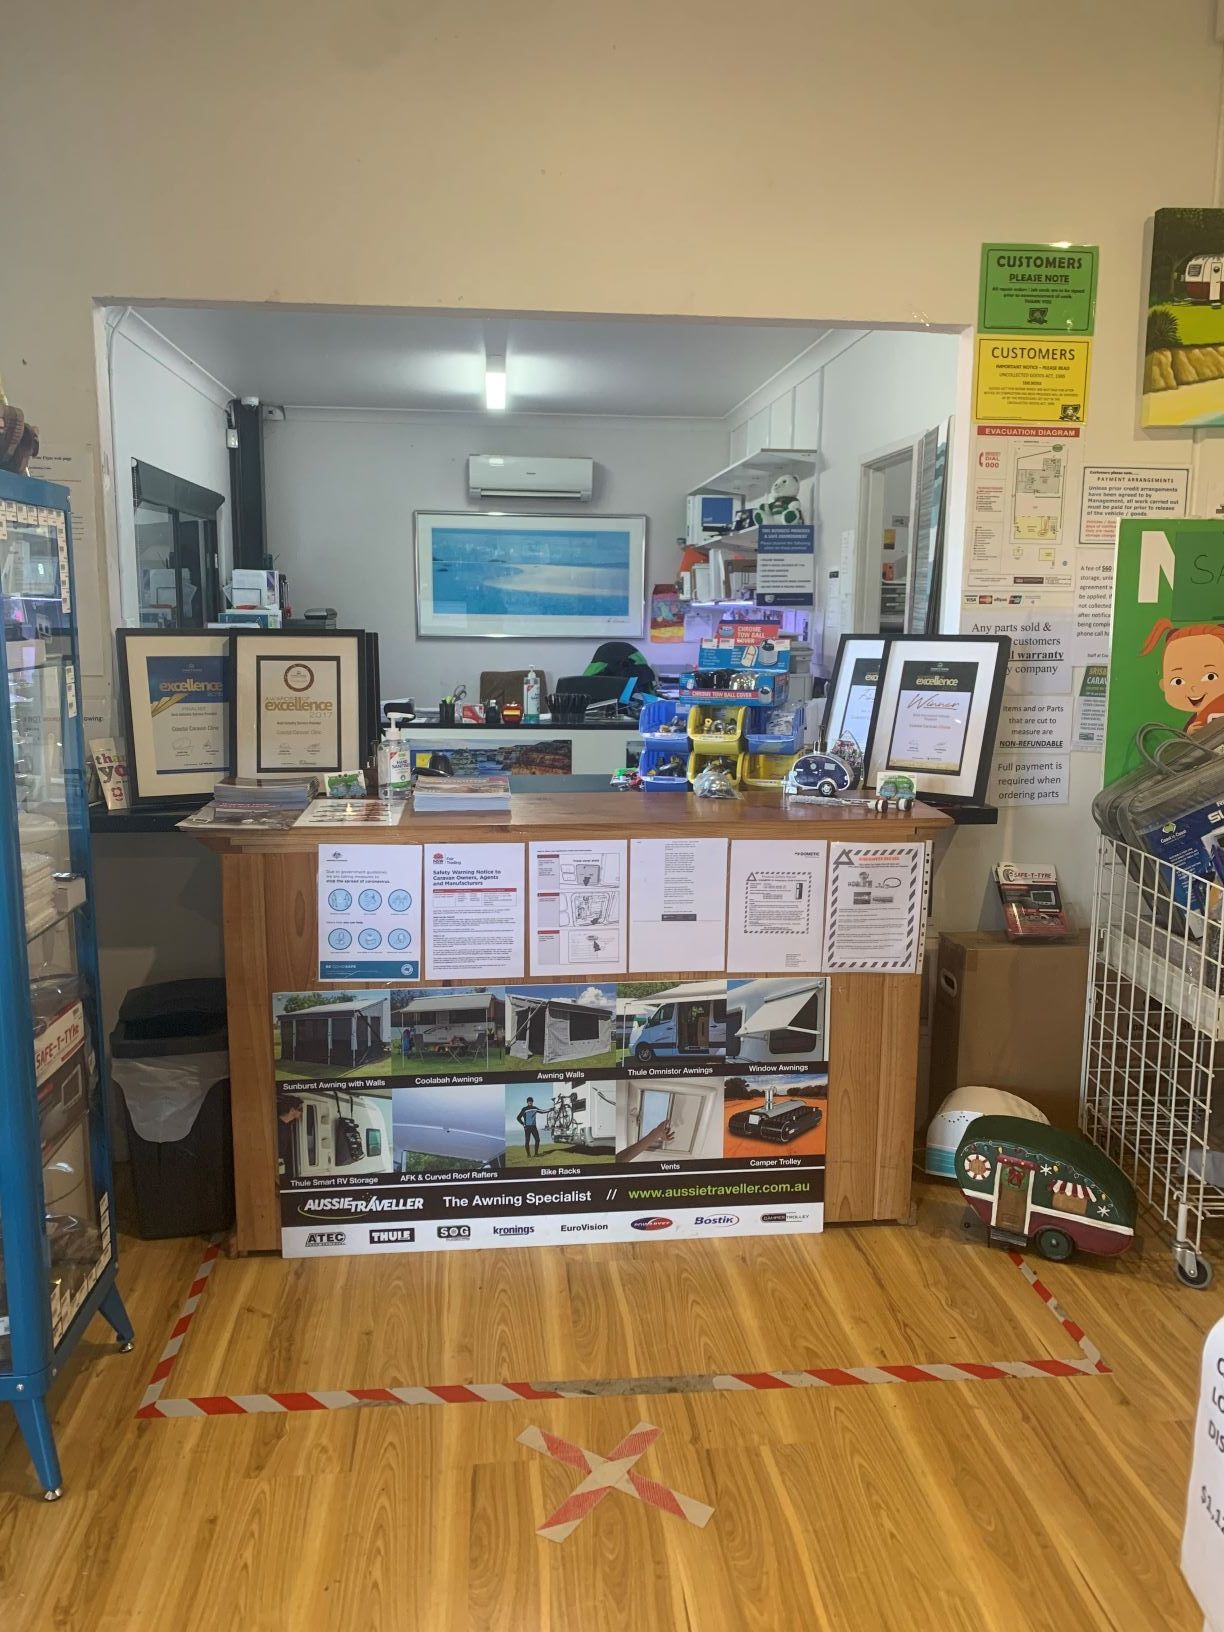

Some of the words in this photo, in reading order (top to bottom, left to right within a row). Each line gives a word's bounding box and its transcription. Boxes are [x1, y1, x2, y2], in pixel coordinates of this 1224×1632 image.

[996, 255, 1082, 269] CUSTOMERS
[1009, 273, 1043, 283] PLEASE
[1045, 275, 1070, 283] NOTE
[992, 346, 1075, 360] CUSTOMERS
[985, 428, 1036, 436] EVACUATION
[972, 623, 992, 634] Any
[994, 623, 1018, 634] parts
[1021, 622, 1040, 632] sold
[1043, 621, 1052, 631] &
[1013, 637, 1061, 646] customers
[1017, 650, 1065, 660] warranty
[1015, 665, 1058, 675] company
[161, 678, 223, 692] excellence
[916, 675, 959, 686] excellence
[264, 697, 333, 711] excellence
[907, 693, 960, 710] Winner
[1023, 704, 1036, 712] and
[999, 740, 1063, 748] NON-REFUNDABLE
[998, 762, 1013, 771] Full
[1015, 762, 1053, 772] payment
[1056, 761, 1062, 770] is
[998, 776, 1035, 786] required
[1037, 775, 1061, 785] when
[998, 790, 1035, 800] ordering
[1038, 790, 1059, 799] parts
[628, 1068, 648, 1076] Thule
[649, 1067, 681, 1076] Omnistor
[683, 1066, 713, 1075] Awnings
[749, 1064, 777, 1072] Window
[779, 1064, 809, 1072] Awnings
[415, 1076, 450, 1085] Coolabah
[452, 1075, 483, 1084] Awnings
[537, 1072, 564, 1080] Awning
[566, 1071, 585, 1079] Walls
[282, 1082, 317, 1091] Sunburst
[319, 1081, 346, 1090] Awning
[366, 1079, 386, 1087] Walls
[660, 1162, 680, 1171] Vents
[750, 1158, 778, 1168] Camper
[779, 1157, 802, 1166] Trolley
[400, 1173, 416, 1181] AFK
[425, 1172, 451, 1181] Curved
[453, 1171, 470, 1180] Roof
[471, 1171, 498, 1179] Rafters
[541, 1167, 557, 1176] Bike
[558, 1167, 581, 1175] Racks
[291, 1179, 311, 1187] Thule
[313, 1178, 335, 1186] Smart
[337, 1177, 348, 1185] RV
[349, 1176, 379, 1185] Storage
[443, 1195, 469, 1208] The
[472, 1194, 523, 1207] Awning
[525, 1190, 592, 1205] Specialist
[628, 1181, 811, 1200] www.aussietraveller.com.au
[694, 1215, 734, 1226] Bostik
[440, 1226, 469, 1238] SOG
[493, 1225, 535, 1236] kronings
[561, 1223, 609, 1232] EuroVision
[307, 1232, 345, 1243] ATEC
[371, 1230, 412, 1242] THULE
